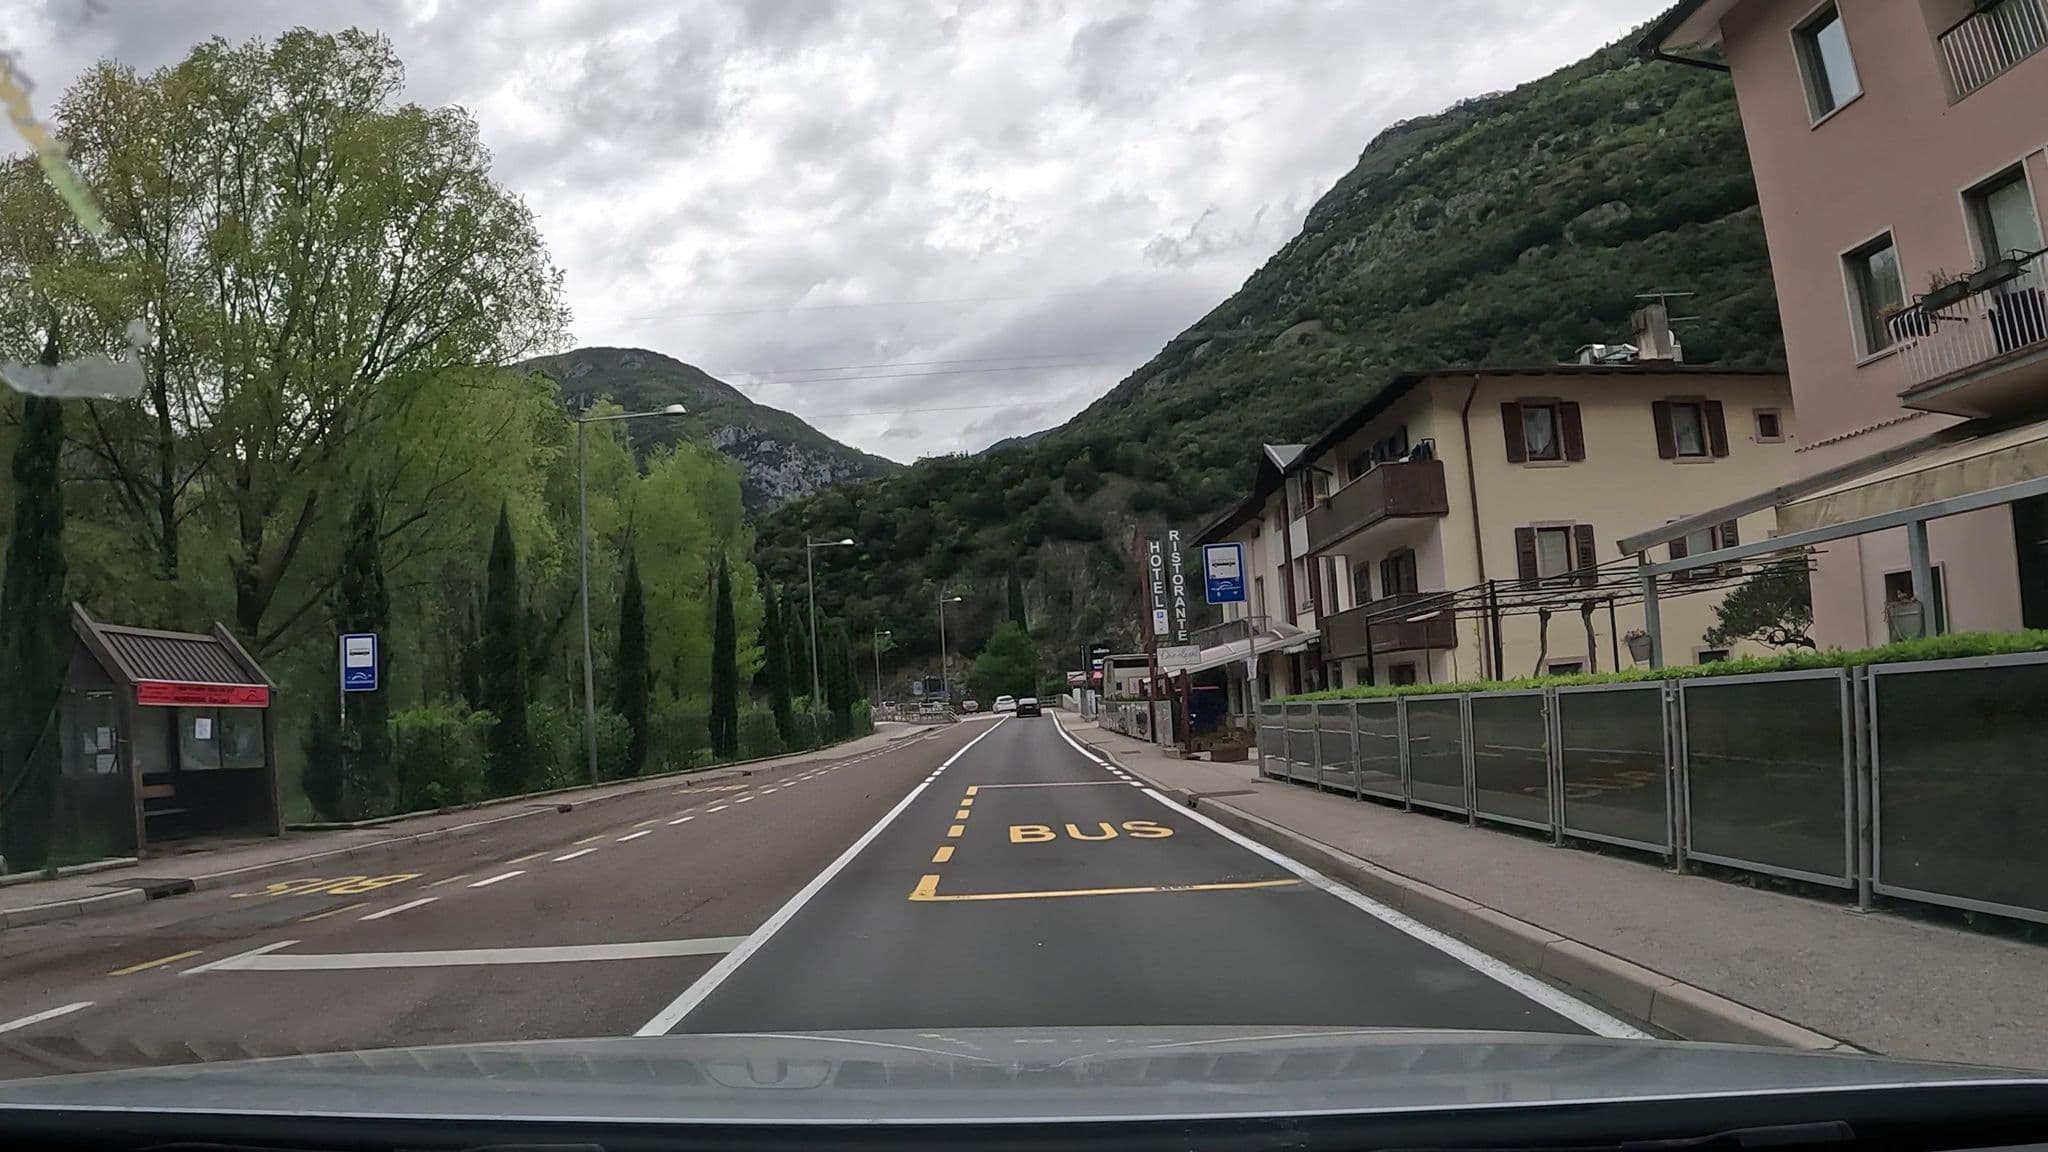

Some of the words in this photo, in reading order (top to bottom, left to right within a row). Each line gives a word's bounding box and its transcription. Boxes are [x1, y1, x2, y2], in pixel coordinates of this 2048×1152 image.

[1150, 541, 1165, 608] HOTEL
[1168, 530, 1188, 642] RISTORANTE
[1009, 820, 1175, 843] BUS
